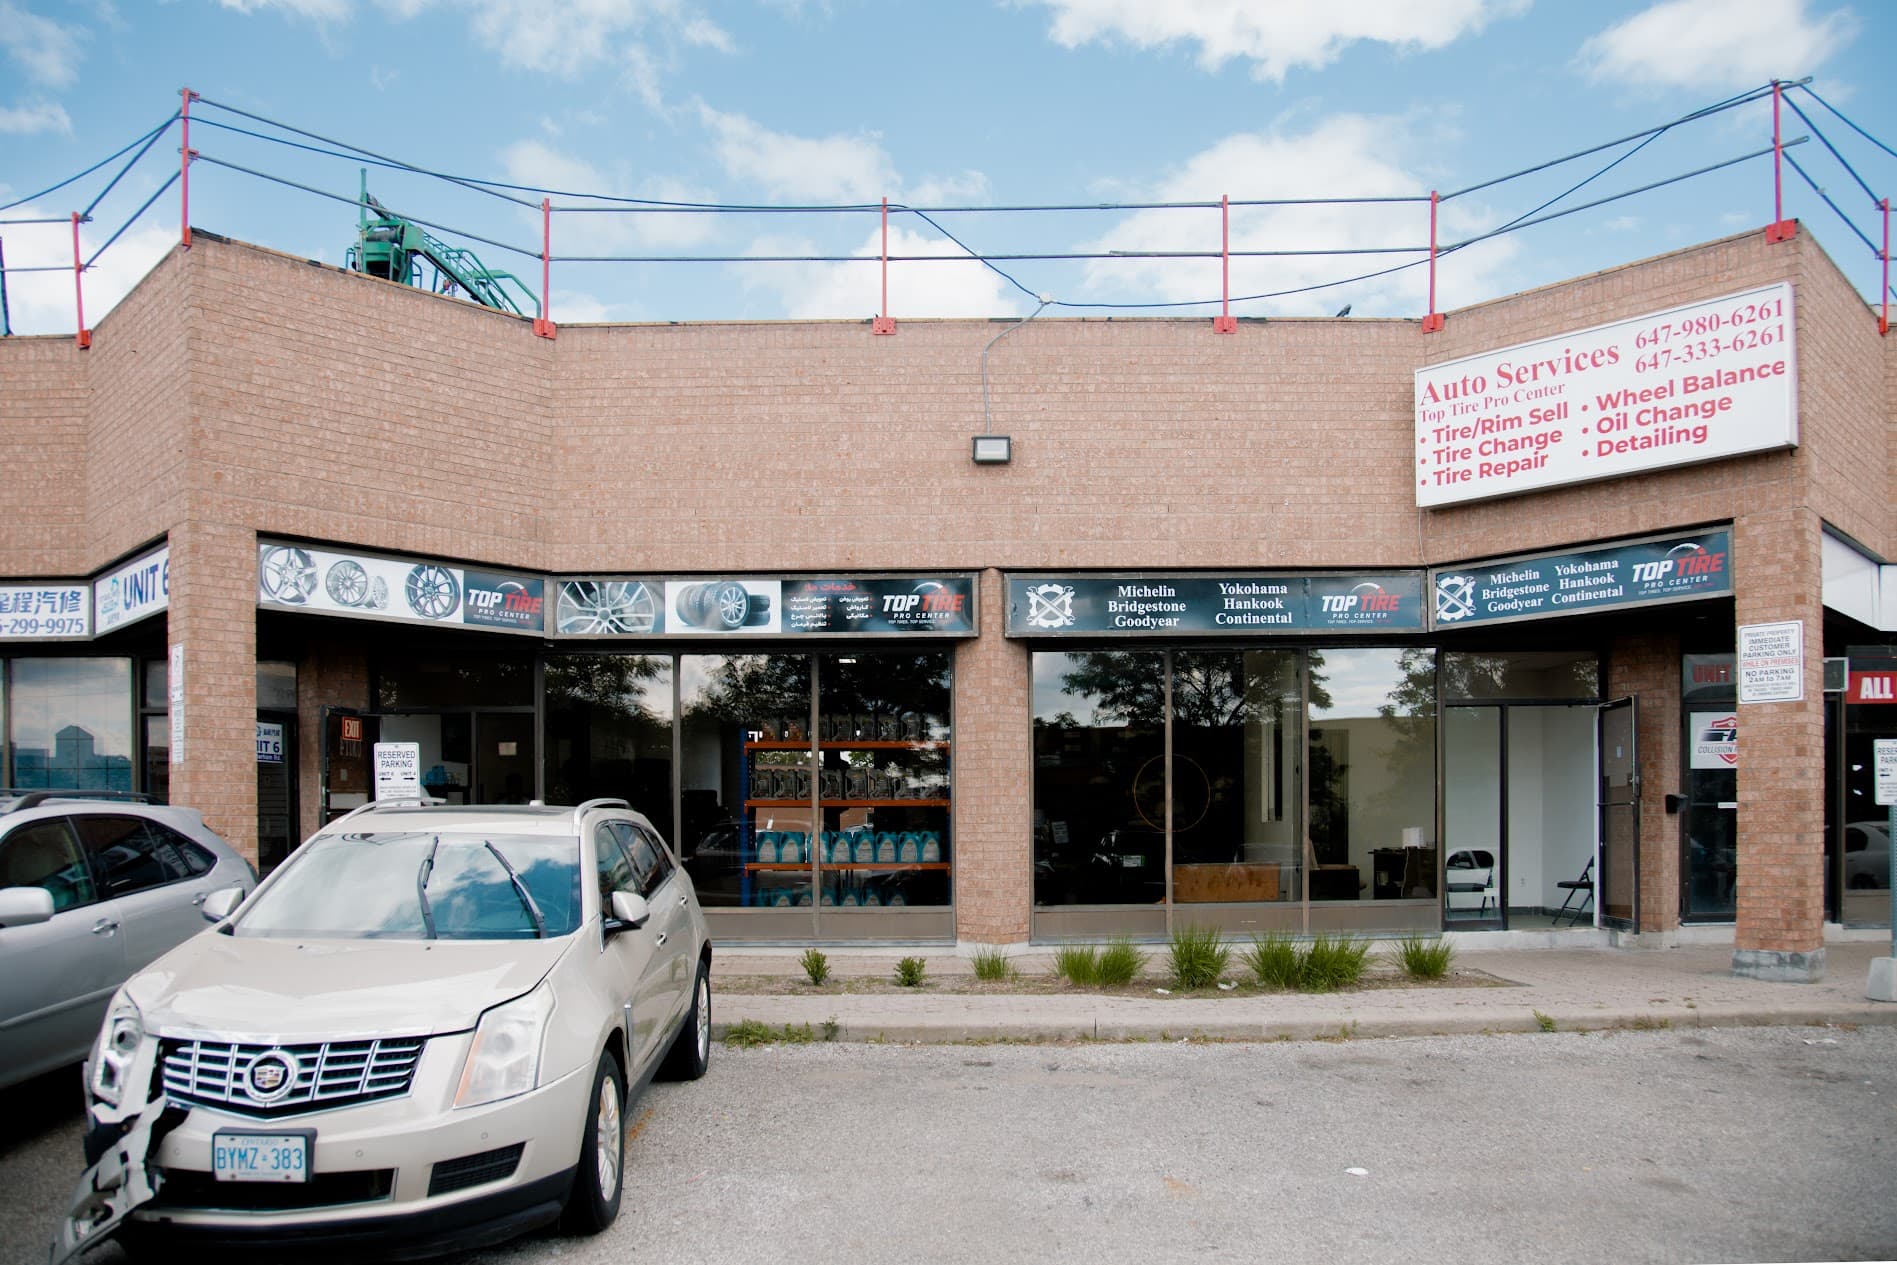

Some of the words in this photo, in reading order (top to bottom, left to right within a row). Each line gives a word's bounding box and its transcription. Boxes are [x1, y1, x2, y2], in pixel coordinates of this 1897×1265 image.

[1635, 298, 1784, 350] 647-980-6261
[1635, 324, 1785, 374] 647-333-6261
[1420, 374, 1487, 406] Auto
[1496, 344, 1620, 389] Services
[1596, 379, 1674, 411] Wheel
[1683, 360, 1785, 395] Balance
[1420, 409, 1445, 423] Top
[1450, 402, 1479, 416] Tire
[1484, 395, 1509, 410] Pro
[1513, 383, 1565, 403] Center
[1432, 415, 1522, 444] Tire/Rim
[1528, 402, 1569, 425] Sell
[1596, 412, 1628, 434] Oil
[1635, 396, 1733, 426] Change
[1432, 446, 1472, 465] Tire
[1478, 429, 1563, 457] Change
[1597, 424, 1708, 458] Detailing
[1433, 467, 1472, 486] Tire
[1479, 451, 1549, 479] Repair
[1554, 559, 1619, 577] Yokohama
[1632, 559, 1673, 583] TOP
[1676, 552, 1726, 577] TIRE
[124, 563, 159, 610] UNIT
[1490, 569, 1540, 586] Michelin
[1559, 572, 1615, 590] Hankook
[1644, 580, 1663, 589] PRO
[1669, 575, 1709, 586] CENTER
[1118, 585, 1176, 598] Michelin
[1219, 583, 1288, 595] Yokohama
[1482, 582, 1550, 600] Bridgestone
[1551, 585, 1623, 604] Continental
[468, 589, 503, 608] TOP
[505, 594, 544, 613] TIRE
[882, 595, 919, 612] TOP
[921, 594, 965, 612] TIRE
[1108, 600, 1186, 615] Bridgestone
[1223, 598, 1284, 610] Hankook
[1322, 595, 1358, 612] TOP
[1361, 594, 1402, 611] TIRE
[1487, 597, 1544, 613] Goodyear
[478, 608, 495, 616] PRO
[498, 610, 530, 620] CENTER
[1115, 615, 1180, 630] Goodyear
[1215, 612, 1292, 625] Continental
[1748, 636, 1791, 644] IMMEDIATE
[1748, 643, 1790, 651] CUSTOMER
[1743, 650, 1775, 658] PARKING
[1693, 664, 1732, 683] UNIT
[1760, 668, 1795, 676] PARKING
[1860, 677, 1893, 699] ALL
[344, 719, 360, 739] EXIT
[257, 740, 270, 752] IT
[273, 741, 280, 753] 6
[378, 751, 416, 759] RESERVED
[1698, 746, 1732, 754] COLLISION
[1878, 747, 1897, 755] RESE
[381, 760, 413, 768] PARKING
[216, 1147, 258, 1170] BYMZ
[271, 1148, 303, 1170] 383
